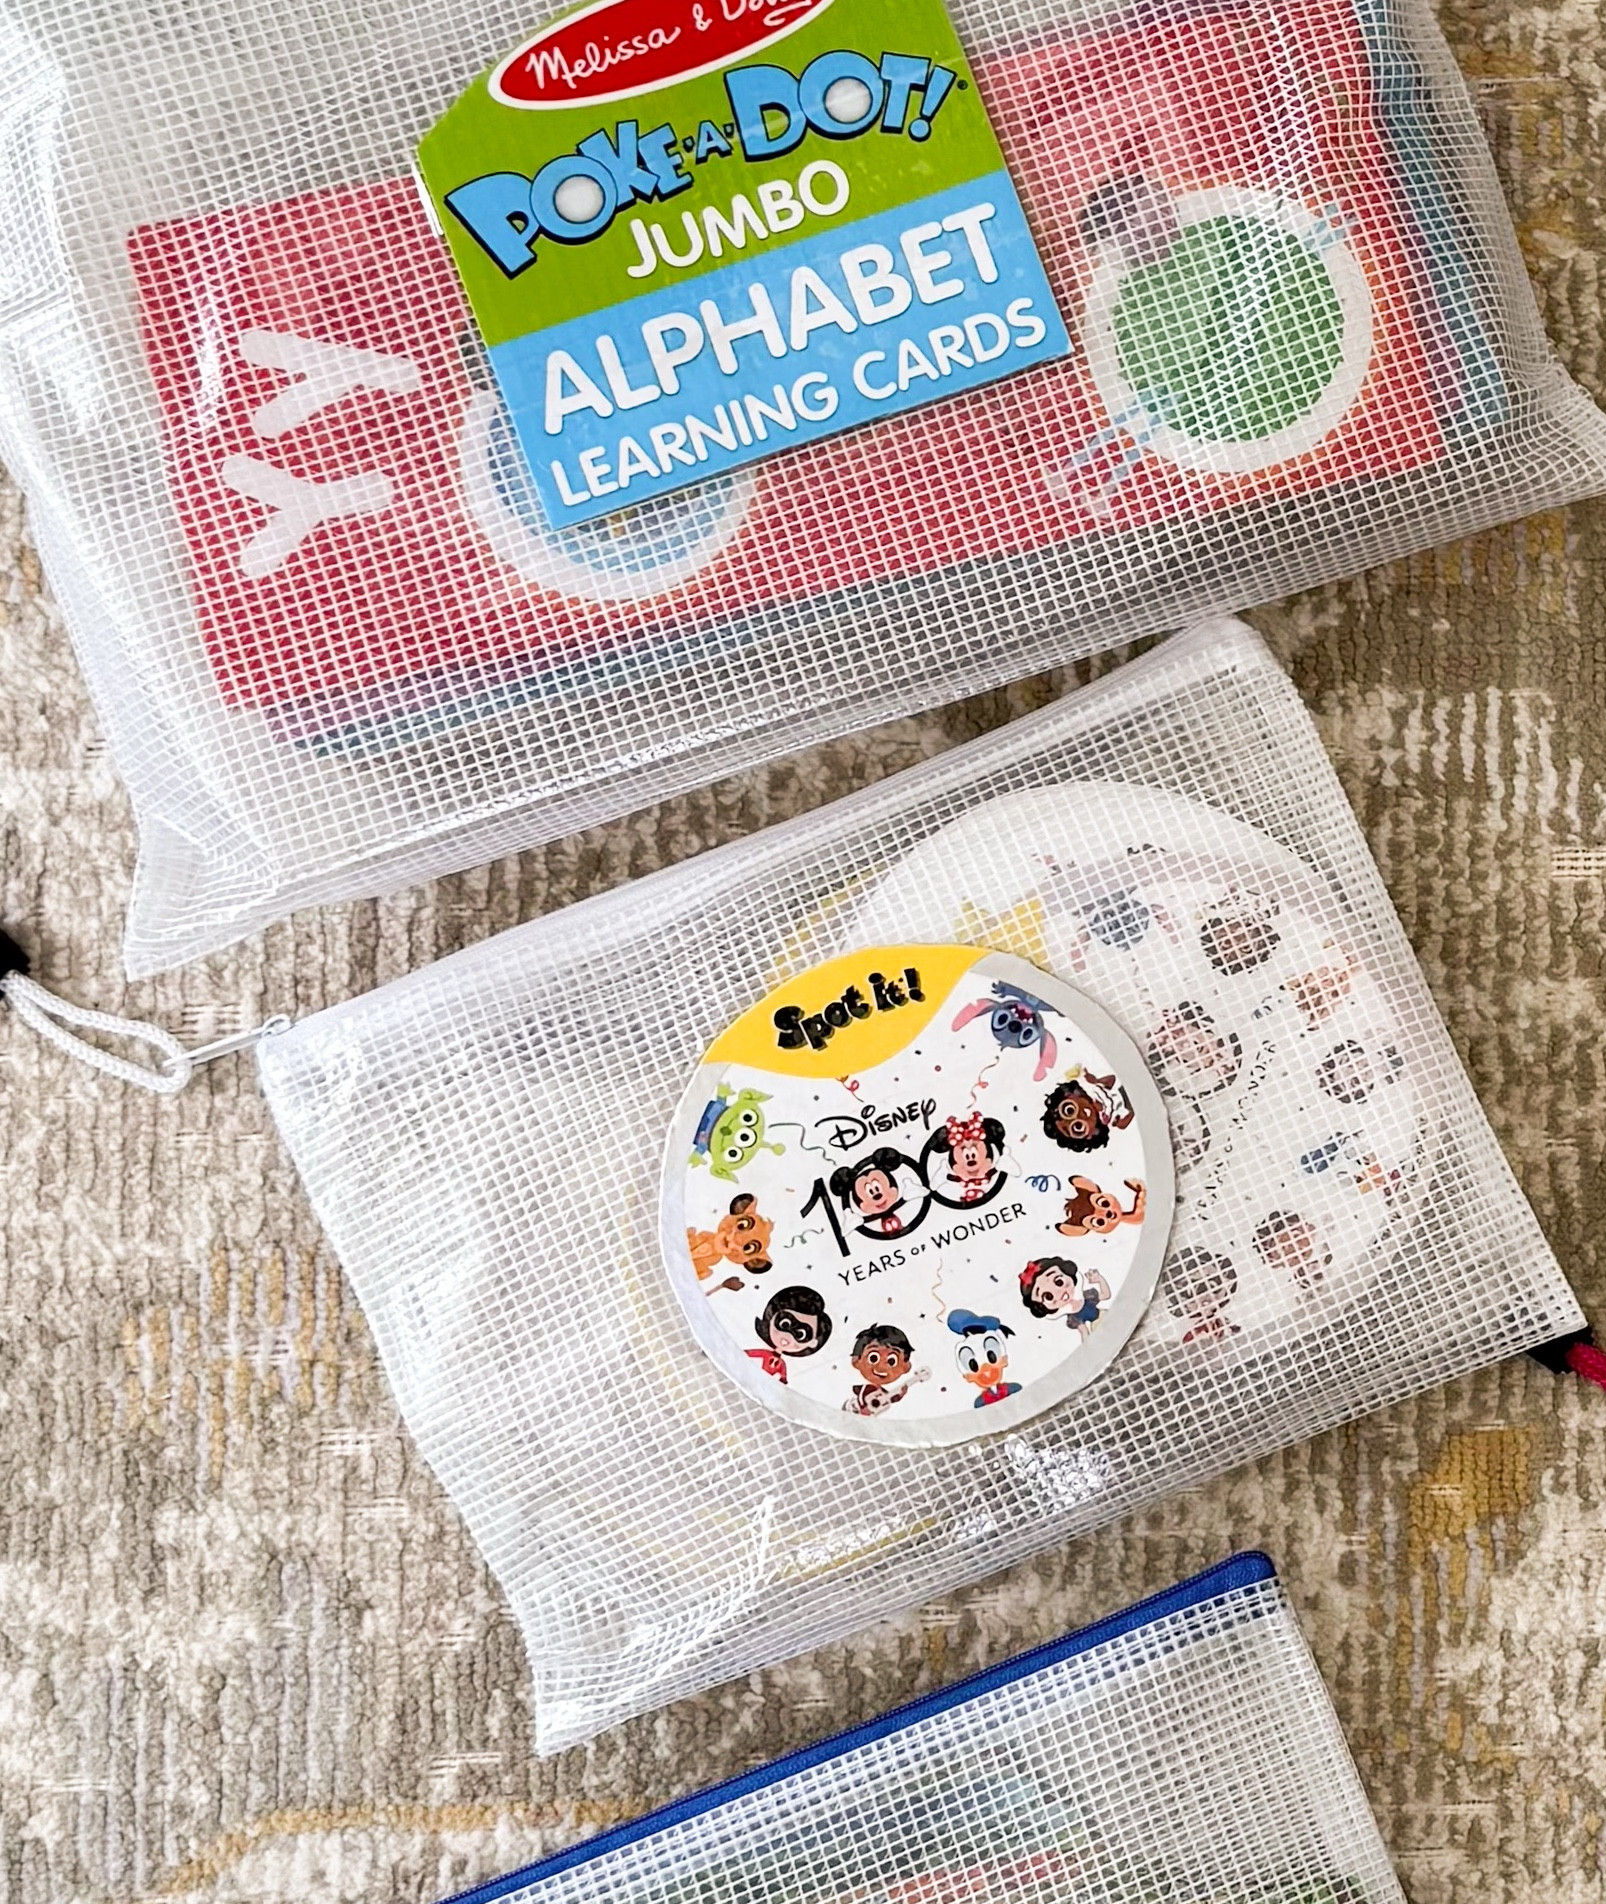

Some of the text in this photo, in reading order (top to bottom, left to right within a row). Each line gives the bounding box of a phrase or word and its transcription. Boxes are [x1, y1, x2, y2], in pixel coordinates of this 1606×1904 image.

[525, 24, 682, 91] Melissa
[692, 5, 711, 31] &
[626, 159, 851, 279] JUMBO
[543, 201, 997, 436] ALPHABET
[550, 297, 1047, 507] LEARNING CARDS
[774, 967, 926, 1051] Spot it!
[814, 1097, 938, 1152] Disney
[837, 1250, 907, 1286] YEARS
[931, 1201, 1027, 1250] WONDER
